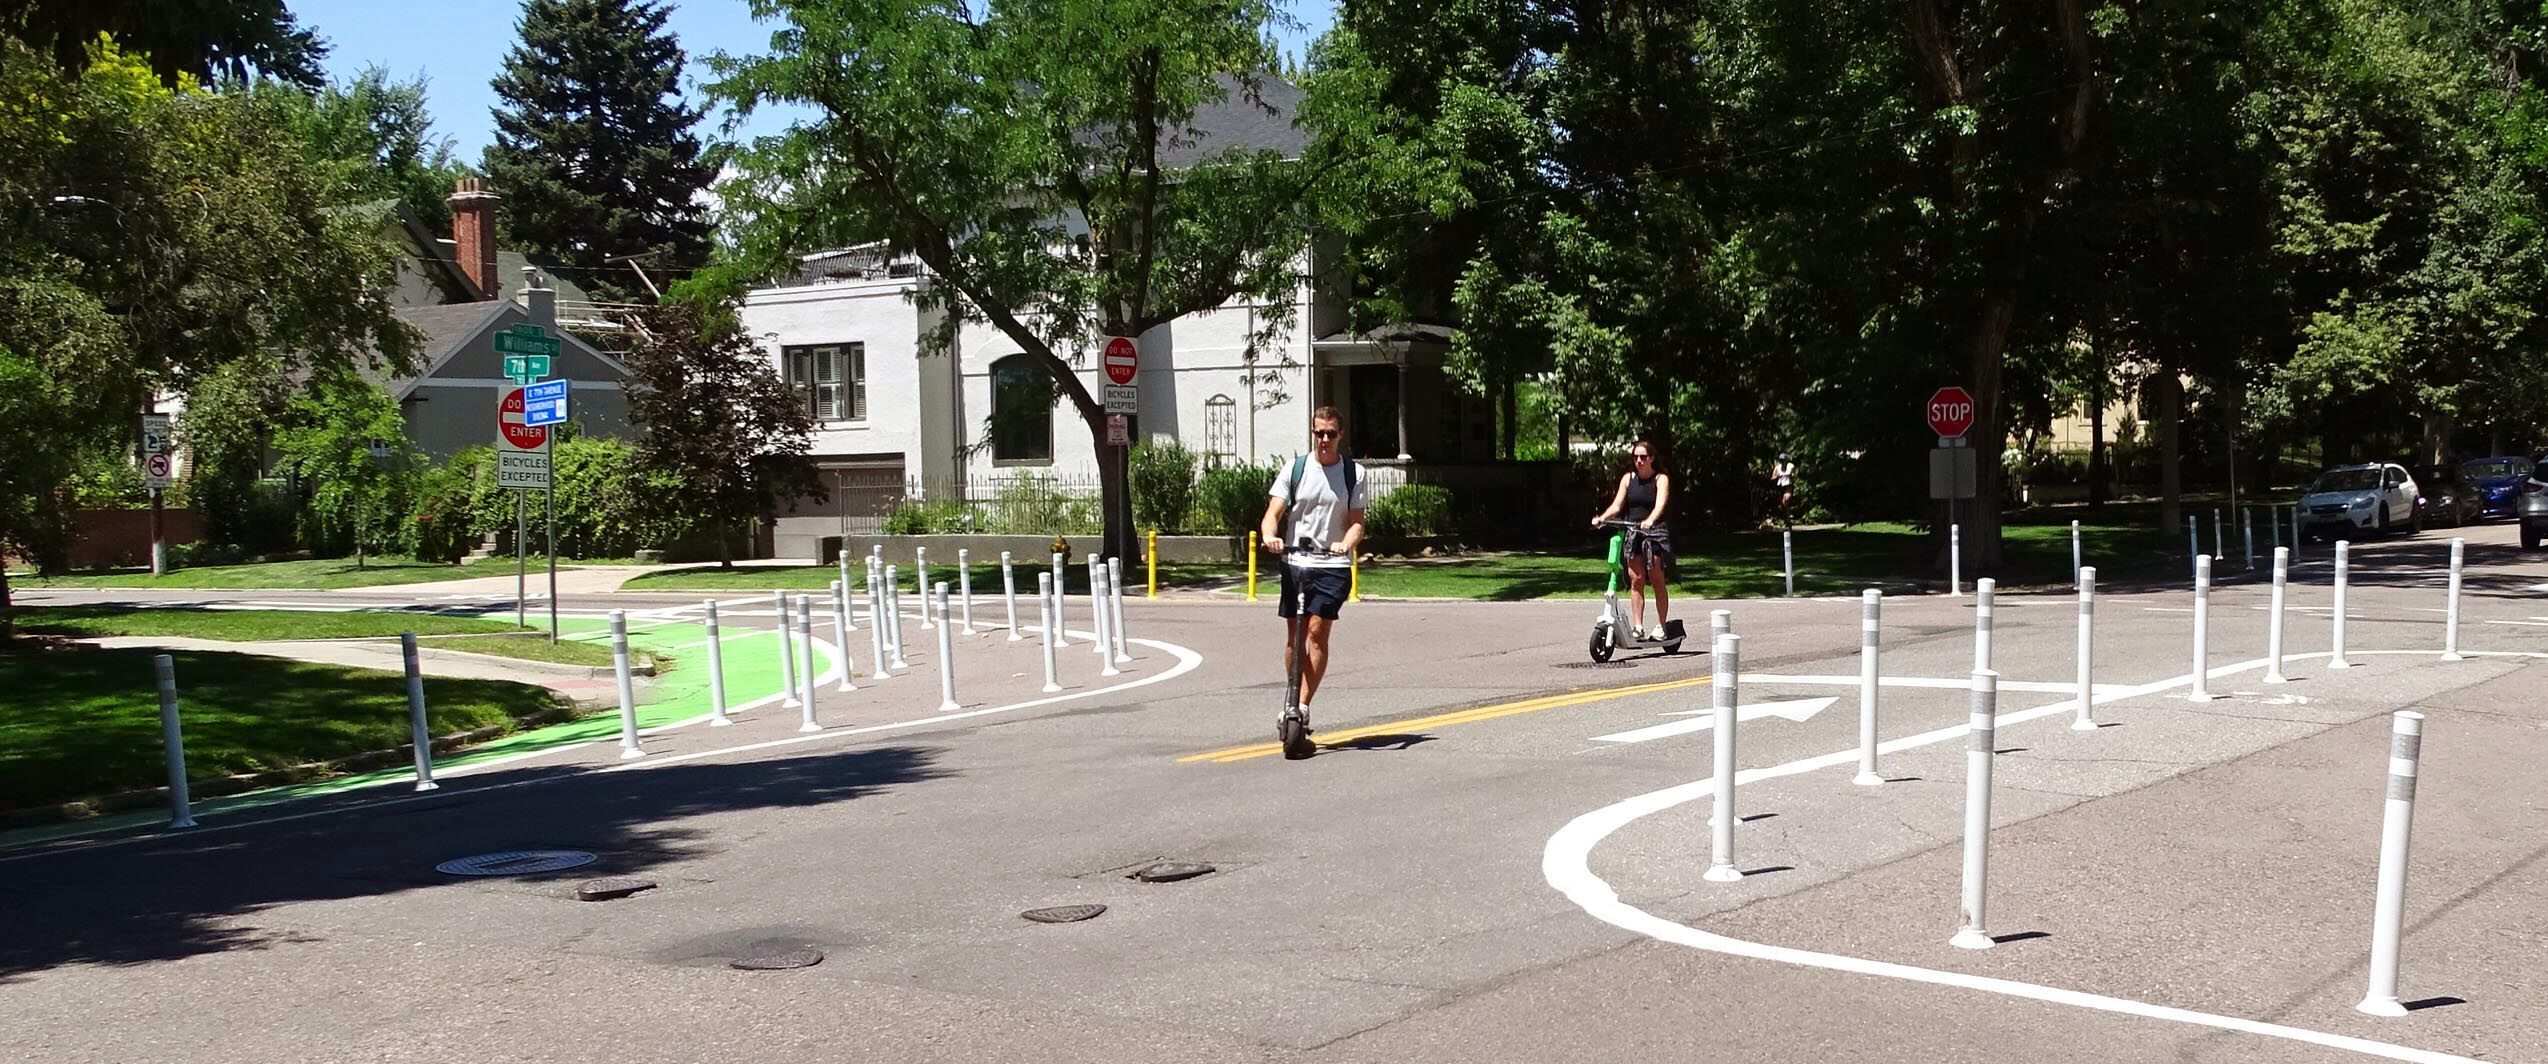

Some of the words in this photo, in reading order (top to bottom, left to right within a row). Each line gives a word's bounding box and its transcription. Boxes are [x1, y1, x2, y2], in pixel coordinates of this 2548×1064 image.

[504, 335, 549, 354] Williams
[1109, 346, 1118, 354] DO
[1121, 347, 1133, 355] NOT
[511, 359, 526, 374] 7th
[507, 399, 521, 410] DO
[1931, 403, 1970, 422] STOP
[510, 426, 542, 438] ENTER
[503, 457, 547, 468] BICYCLES
